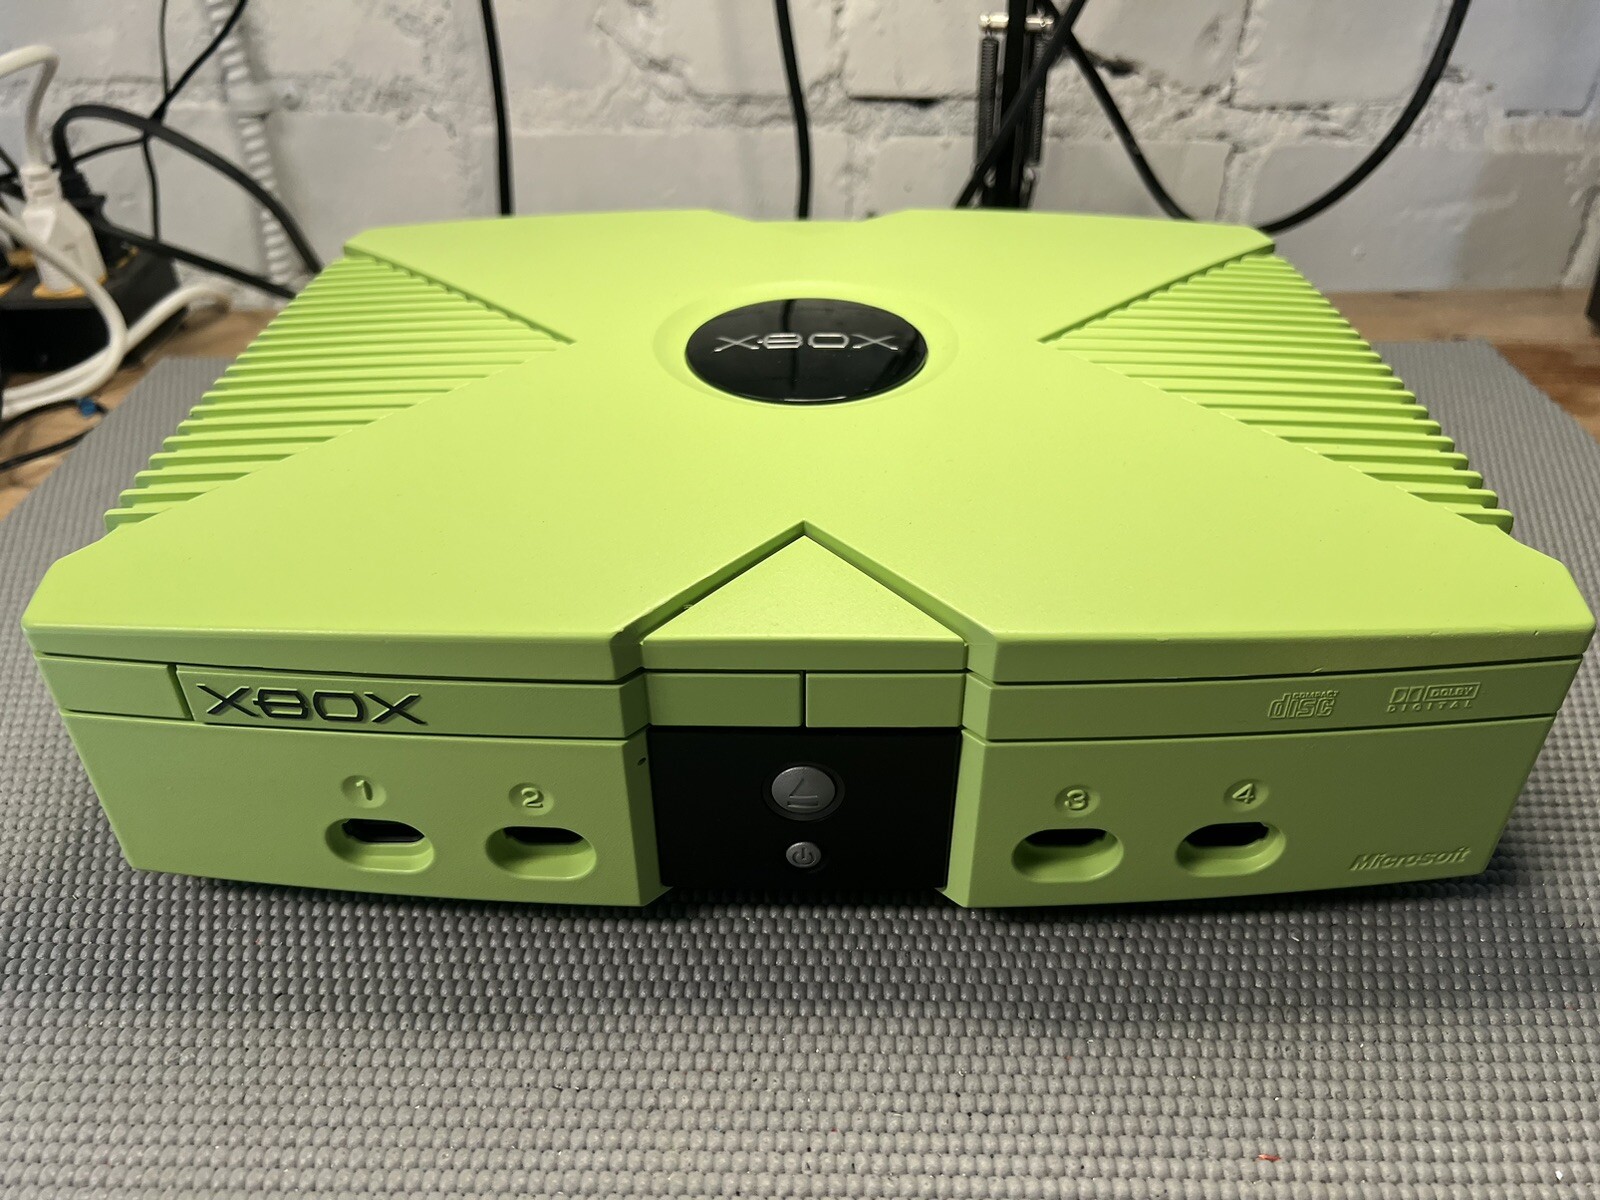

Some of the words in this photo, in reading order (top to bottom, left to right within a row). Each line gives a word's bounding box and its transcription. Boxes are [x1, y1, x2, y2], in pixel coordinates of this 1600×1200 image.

[712, 332, 900, 353] XBOX
[1292, 689, 1340, 700] COMPACT
[1429, 686, 1474, 698] DOLBY
[196, 683, 428, 725] XBOX
[1386, 699, 1474, 713] DIGITAL
[354, 779, 374, 801] 1
[520, 787, 544, 809] 2
[1064, 788, 1090, 811] 3
[1232, 782, 1256, 805] 4
[1349, 846, 1472, 872] Microsoft
